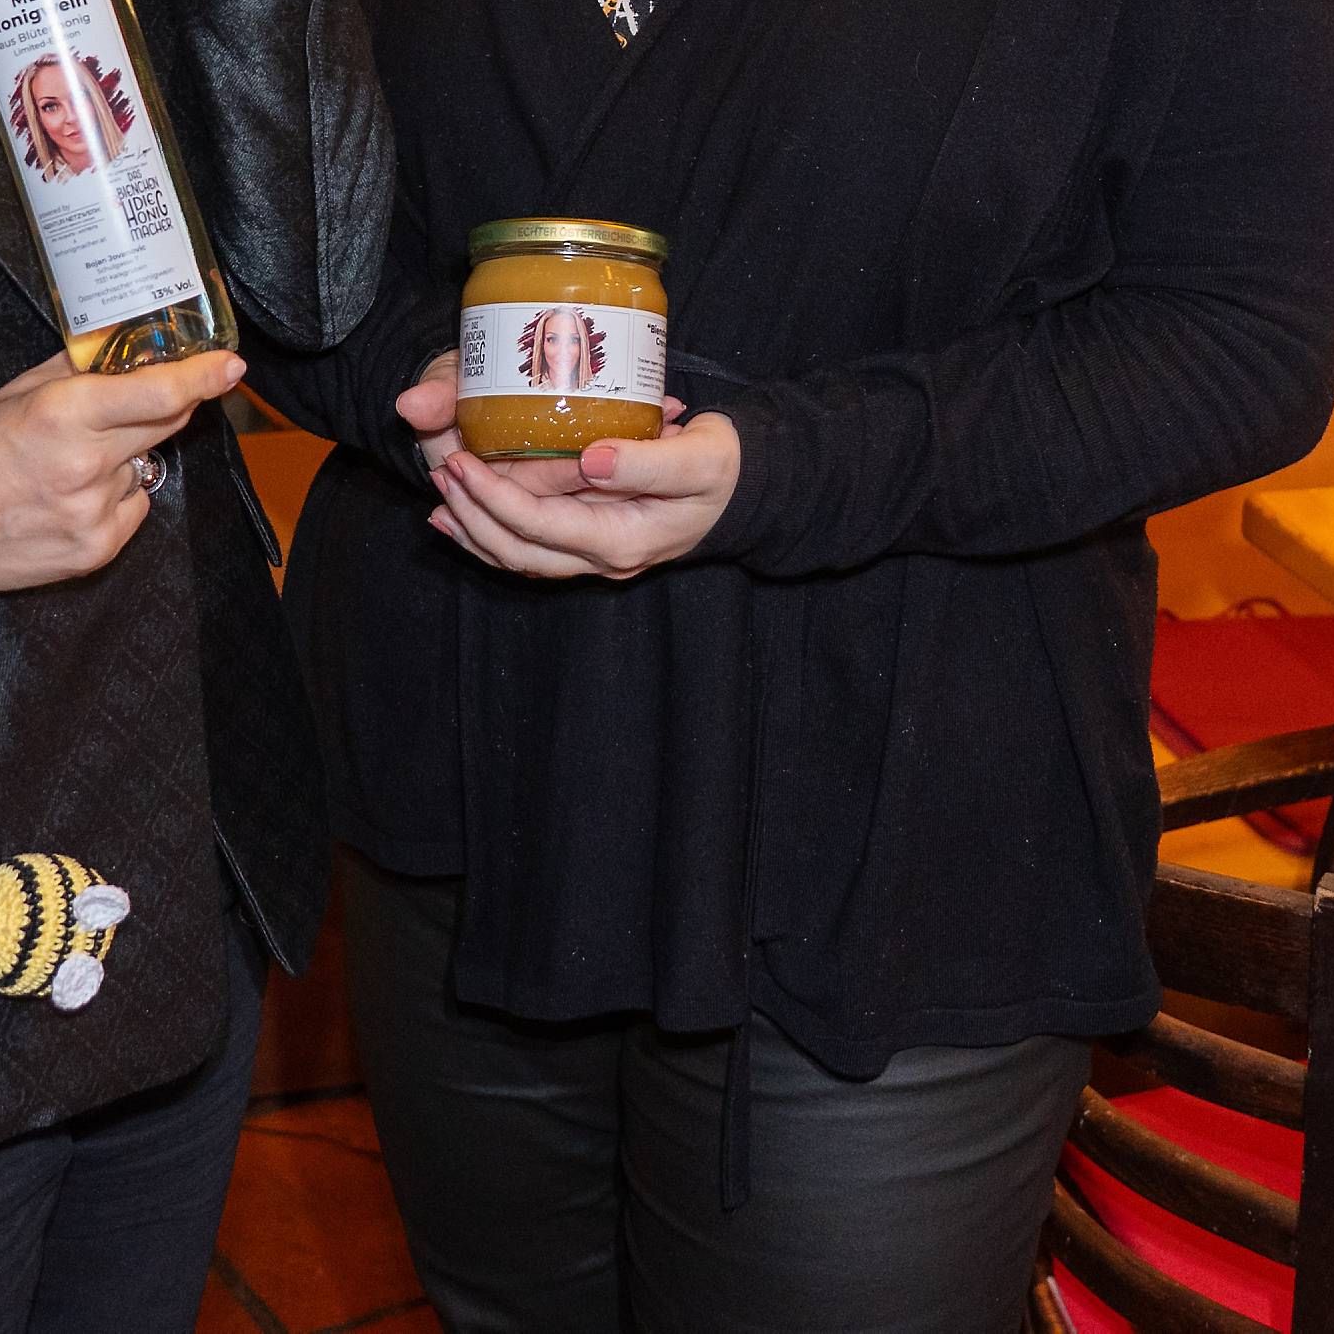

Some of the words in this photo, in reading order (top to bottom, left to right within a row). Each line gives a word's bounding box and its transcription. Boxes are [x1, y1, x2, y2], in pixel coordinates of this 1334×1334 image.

[0, 38, 17, 50] aus
[18, 13, 91, 43] Blüteonig
[127, 169, 143, 182] DAS
[116, 176, 160, 200] BIENCHEN
[122, 190, 168, 228] HONIG
[133, 192, 156, 211] DIE
[130, 218, 174, 241] MACHER
[518, 226, 557, 238] ECHTER
[151, 285, 173, 300] 13%
[174, 279, 195, 292] Vol.
